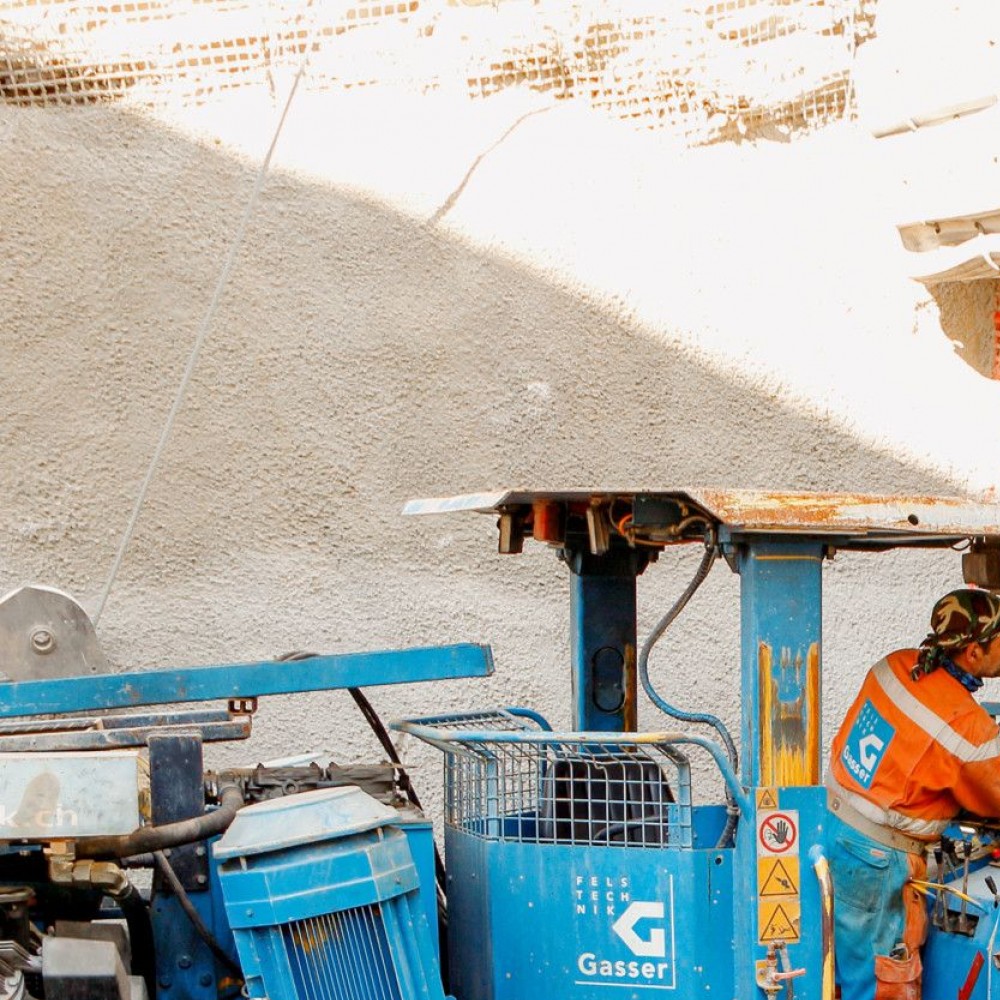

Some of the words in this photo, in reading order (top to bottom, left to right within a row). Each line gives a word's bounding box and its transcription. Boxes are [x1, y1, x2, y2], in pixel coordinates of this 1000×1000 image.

[576, 876, 629, 888] FELS
[576, 890, 631, 902] TECH
[576, 904, 615, 916] NIK
[577, 952, 668, 980] Gasser
